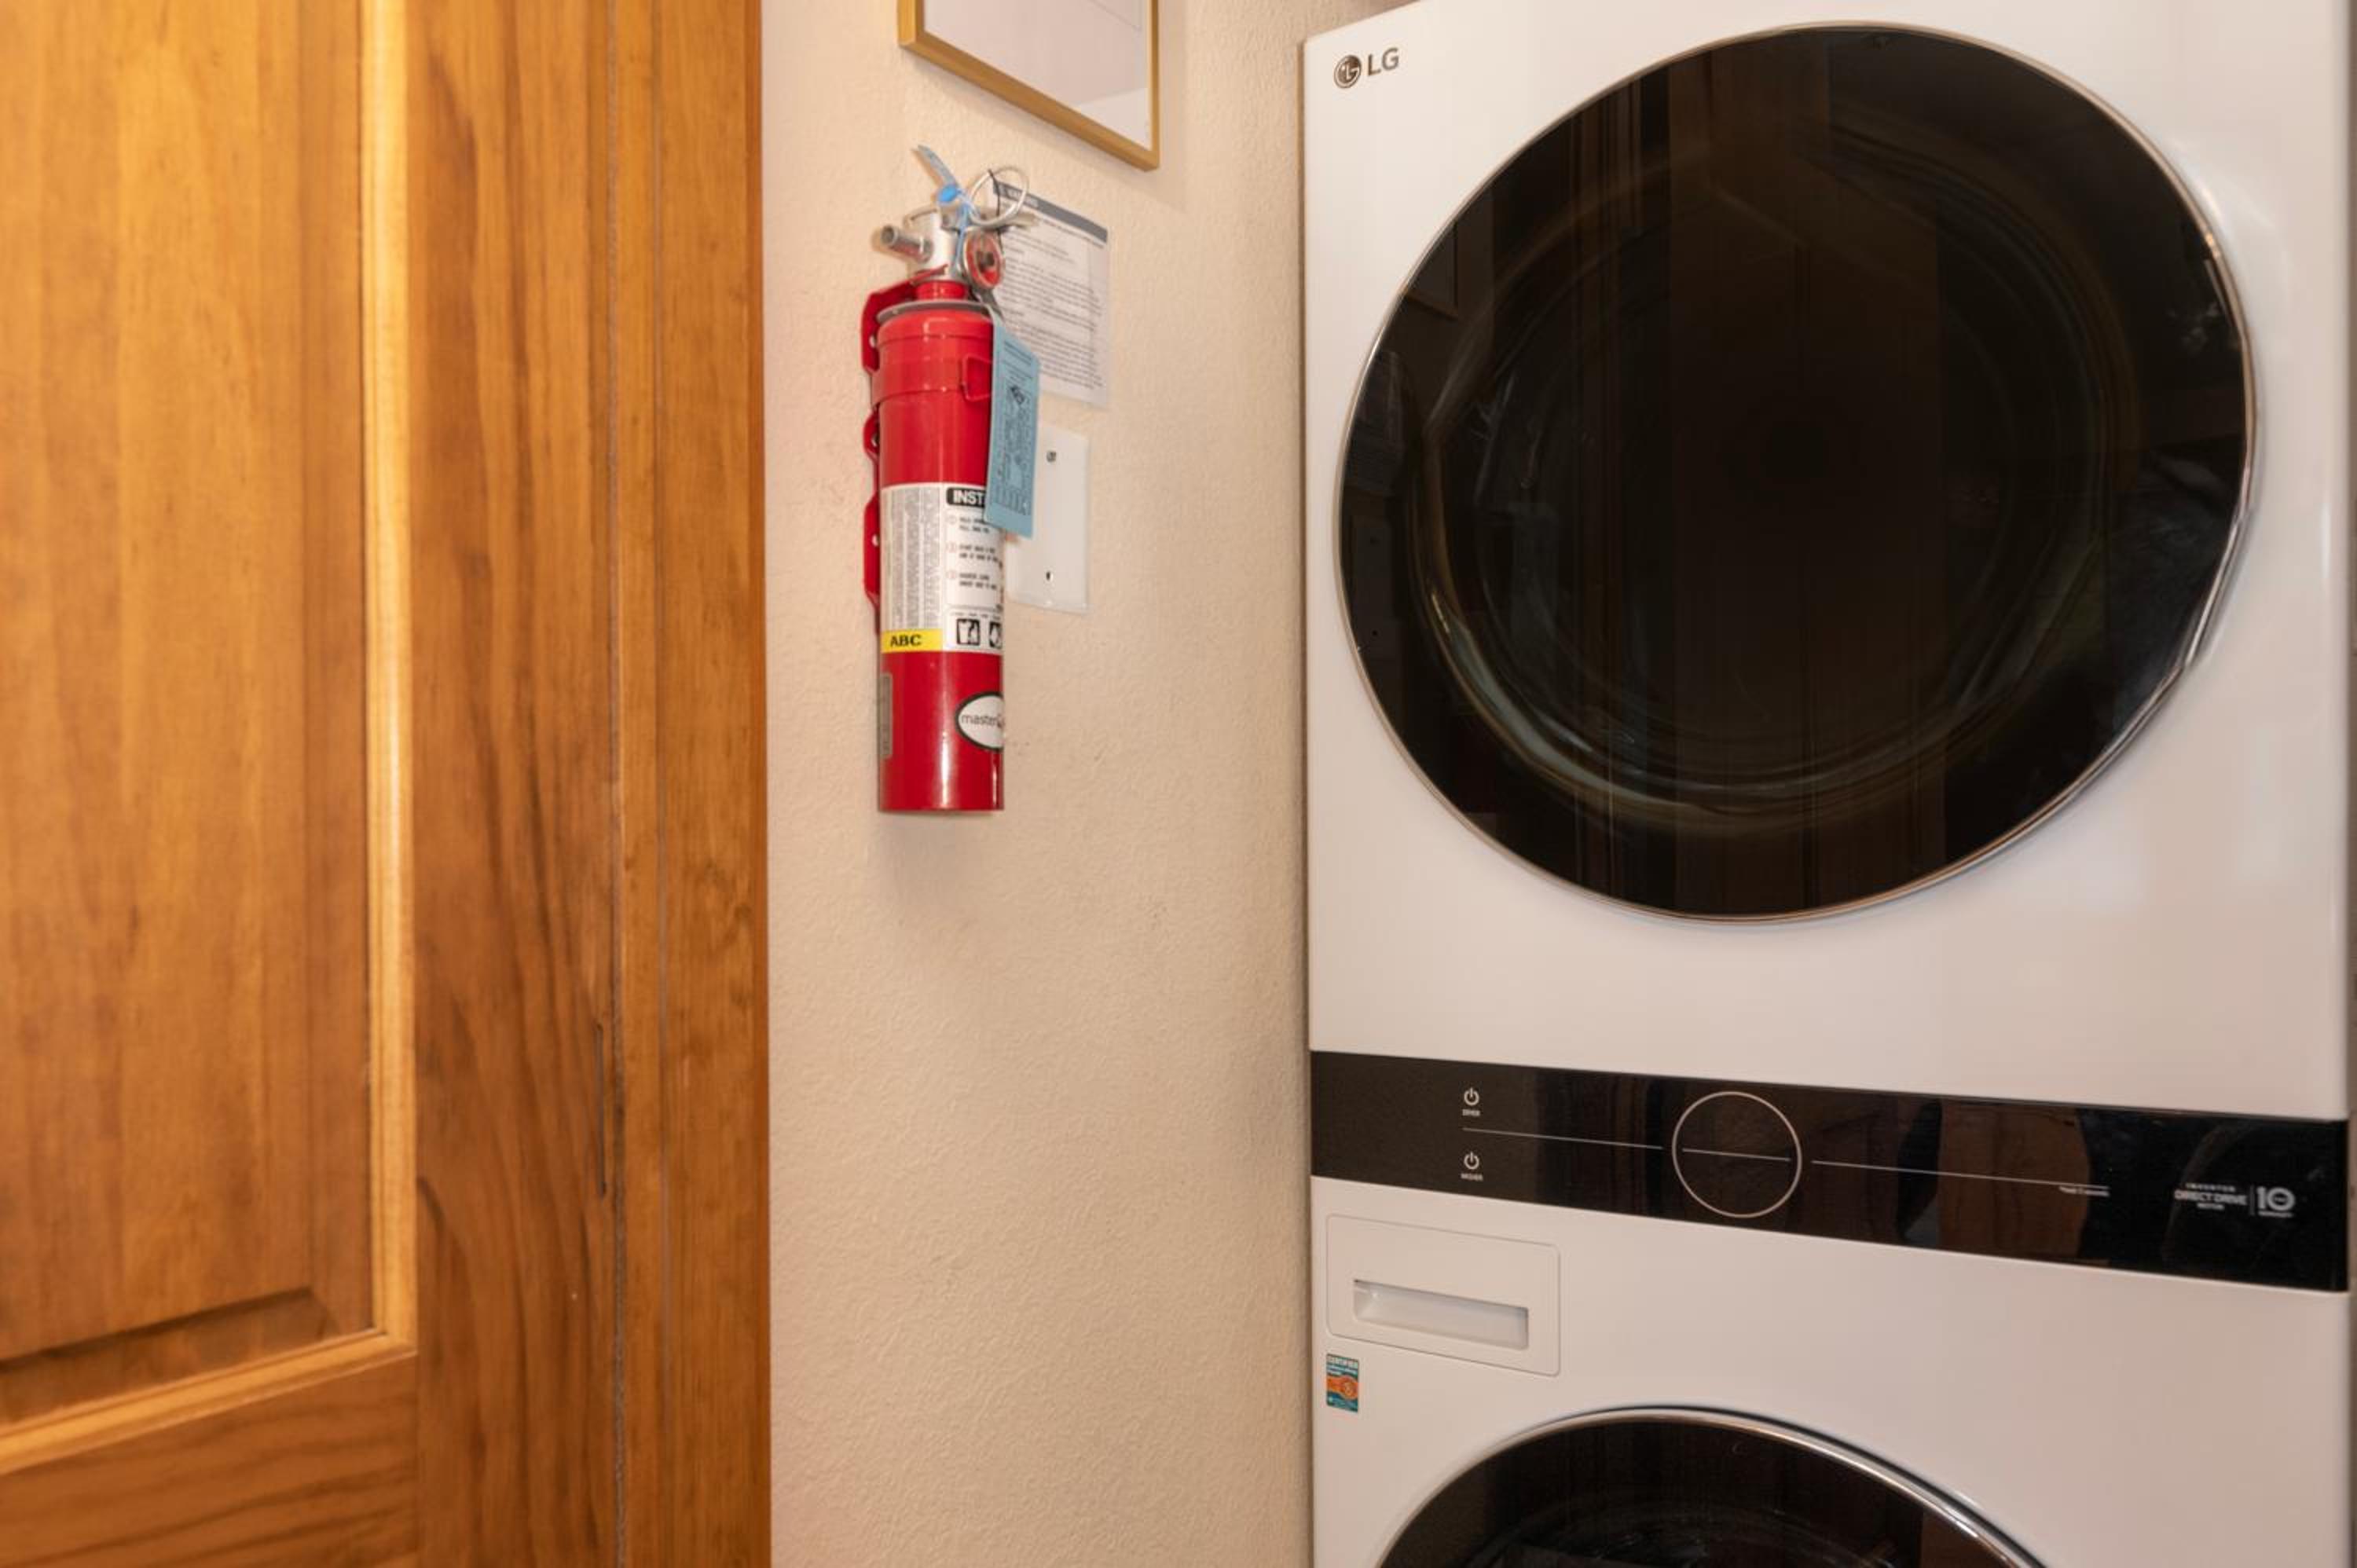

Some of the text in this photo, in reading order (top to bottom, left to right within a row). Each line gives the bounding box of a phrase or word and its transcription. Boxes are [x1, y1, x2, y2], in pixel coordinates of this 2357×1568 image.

[1368, 47, 1399, 76] LG
[889, 634, 922, 647] ABC
[2174, 1188, 2248, 1206] DIRECT DRIVE
[2256, 1186, 2296, 1211] 10
